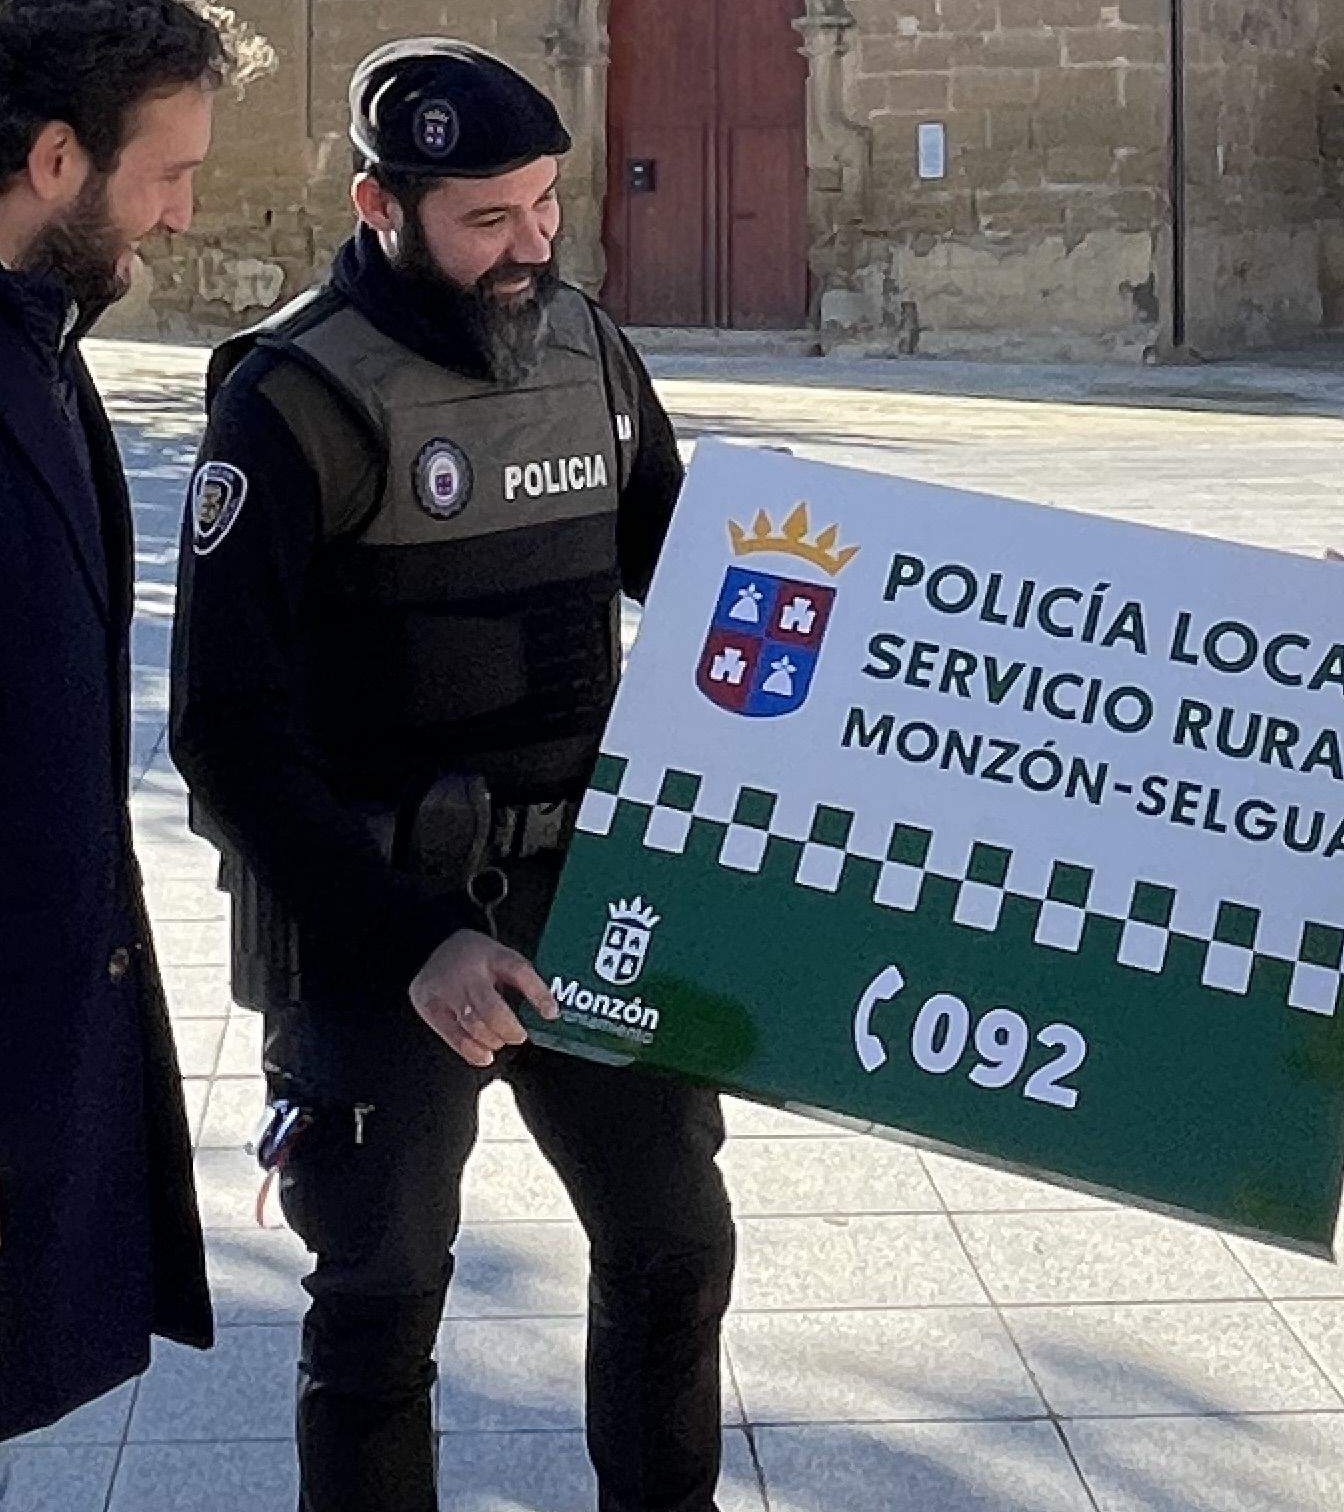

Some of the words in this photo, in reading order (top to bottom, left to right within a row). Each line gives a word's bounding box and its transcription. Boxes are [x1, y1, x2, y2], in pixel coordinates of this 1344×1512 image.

[504, 454, 607, 500] POLICIA
[882, 552, 1148, 656] POLICÍA
[860, 632, 1155, 735] SERVICIO
[550, 975, 660, 1030] Monzón
[911, 993, 1087, 1109] 092
